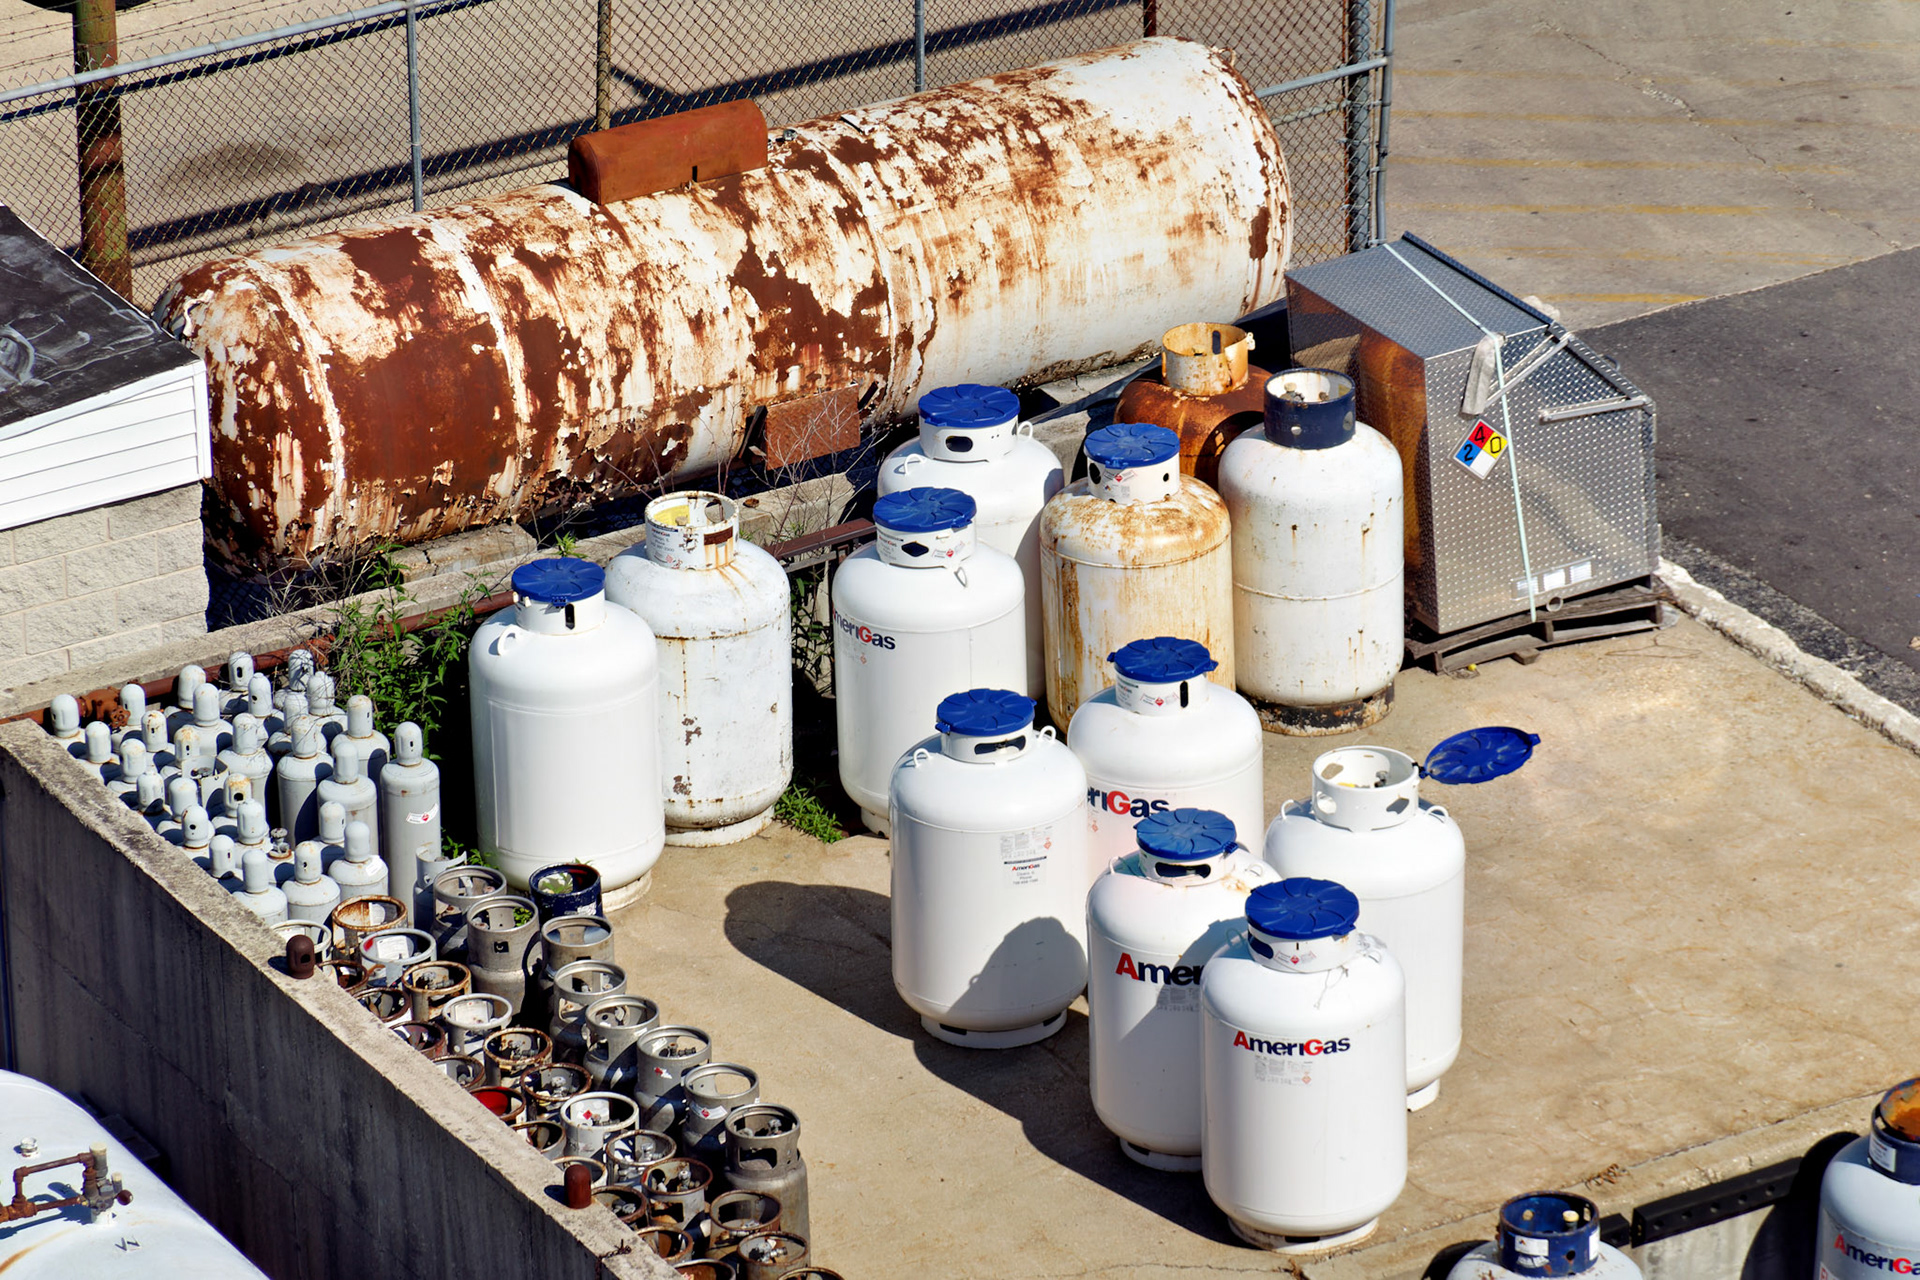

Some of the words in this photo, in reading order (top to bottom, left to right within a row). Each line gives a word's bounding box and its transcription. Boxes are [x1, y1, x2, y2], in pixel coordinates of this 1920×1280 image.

[1474, 426, 1485, 443] 4
[1490, 436, 1501, 454] 0
[1464, 444, 1473, 462] 2
[1115, 952, 1205, 986] Amer
[1233, 1030, 1351, 1056] AmeriGas
[1833, 1233, 1920, 1275] AmeriGa
